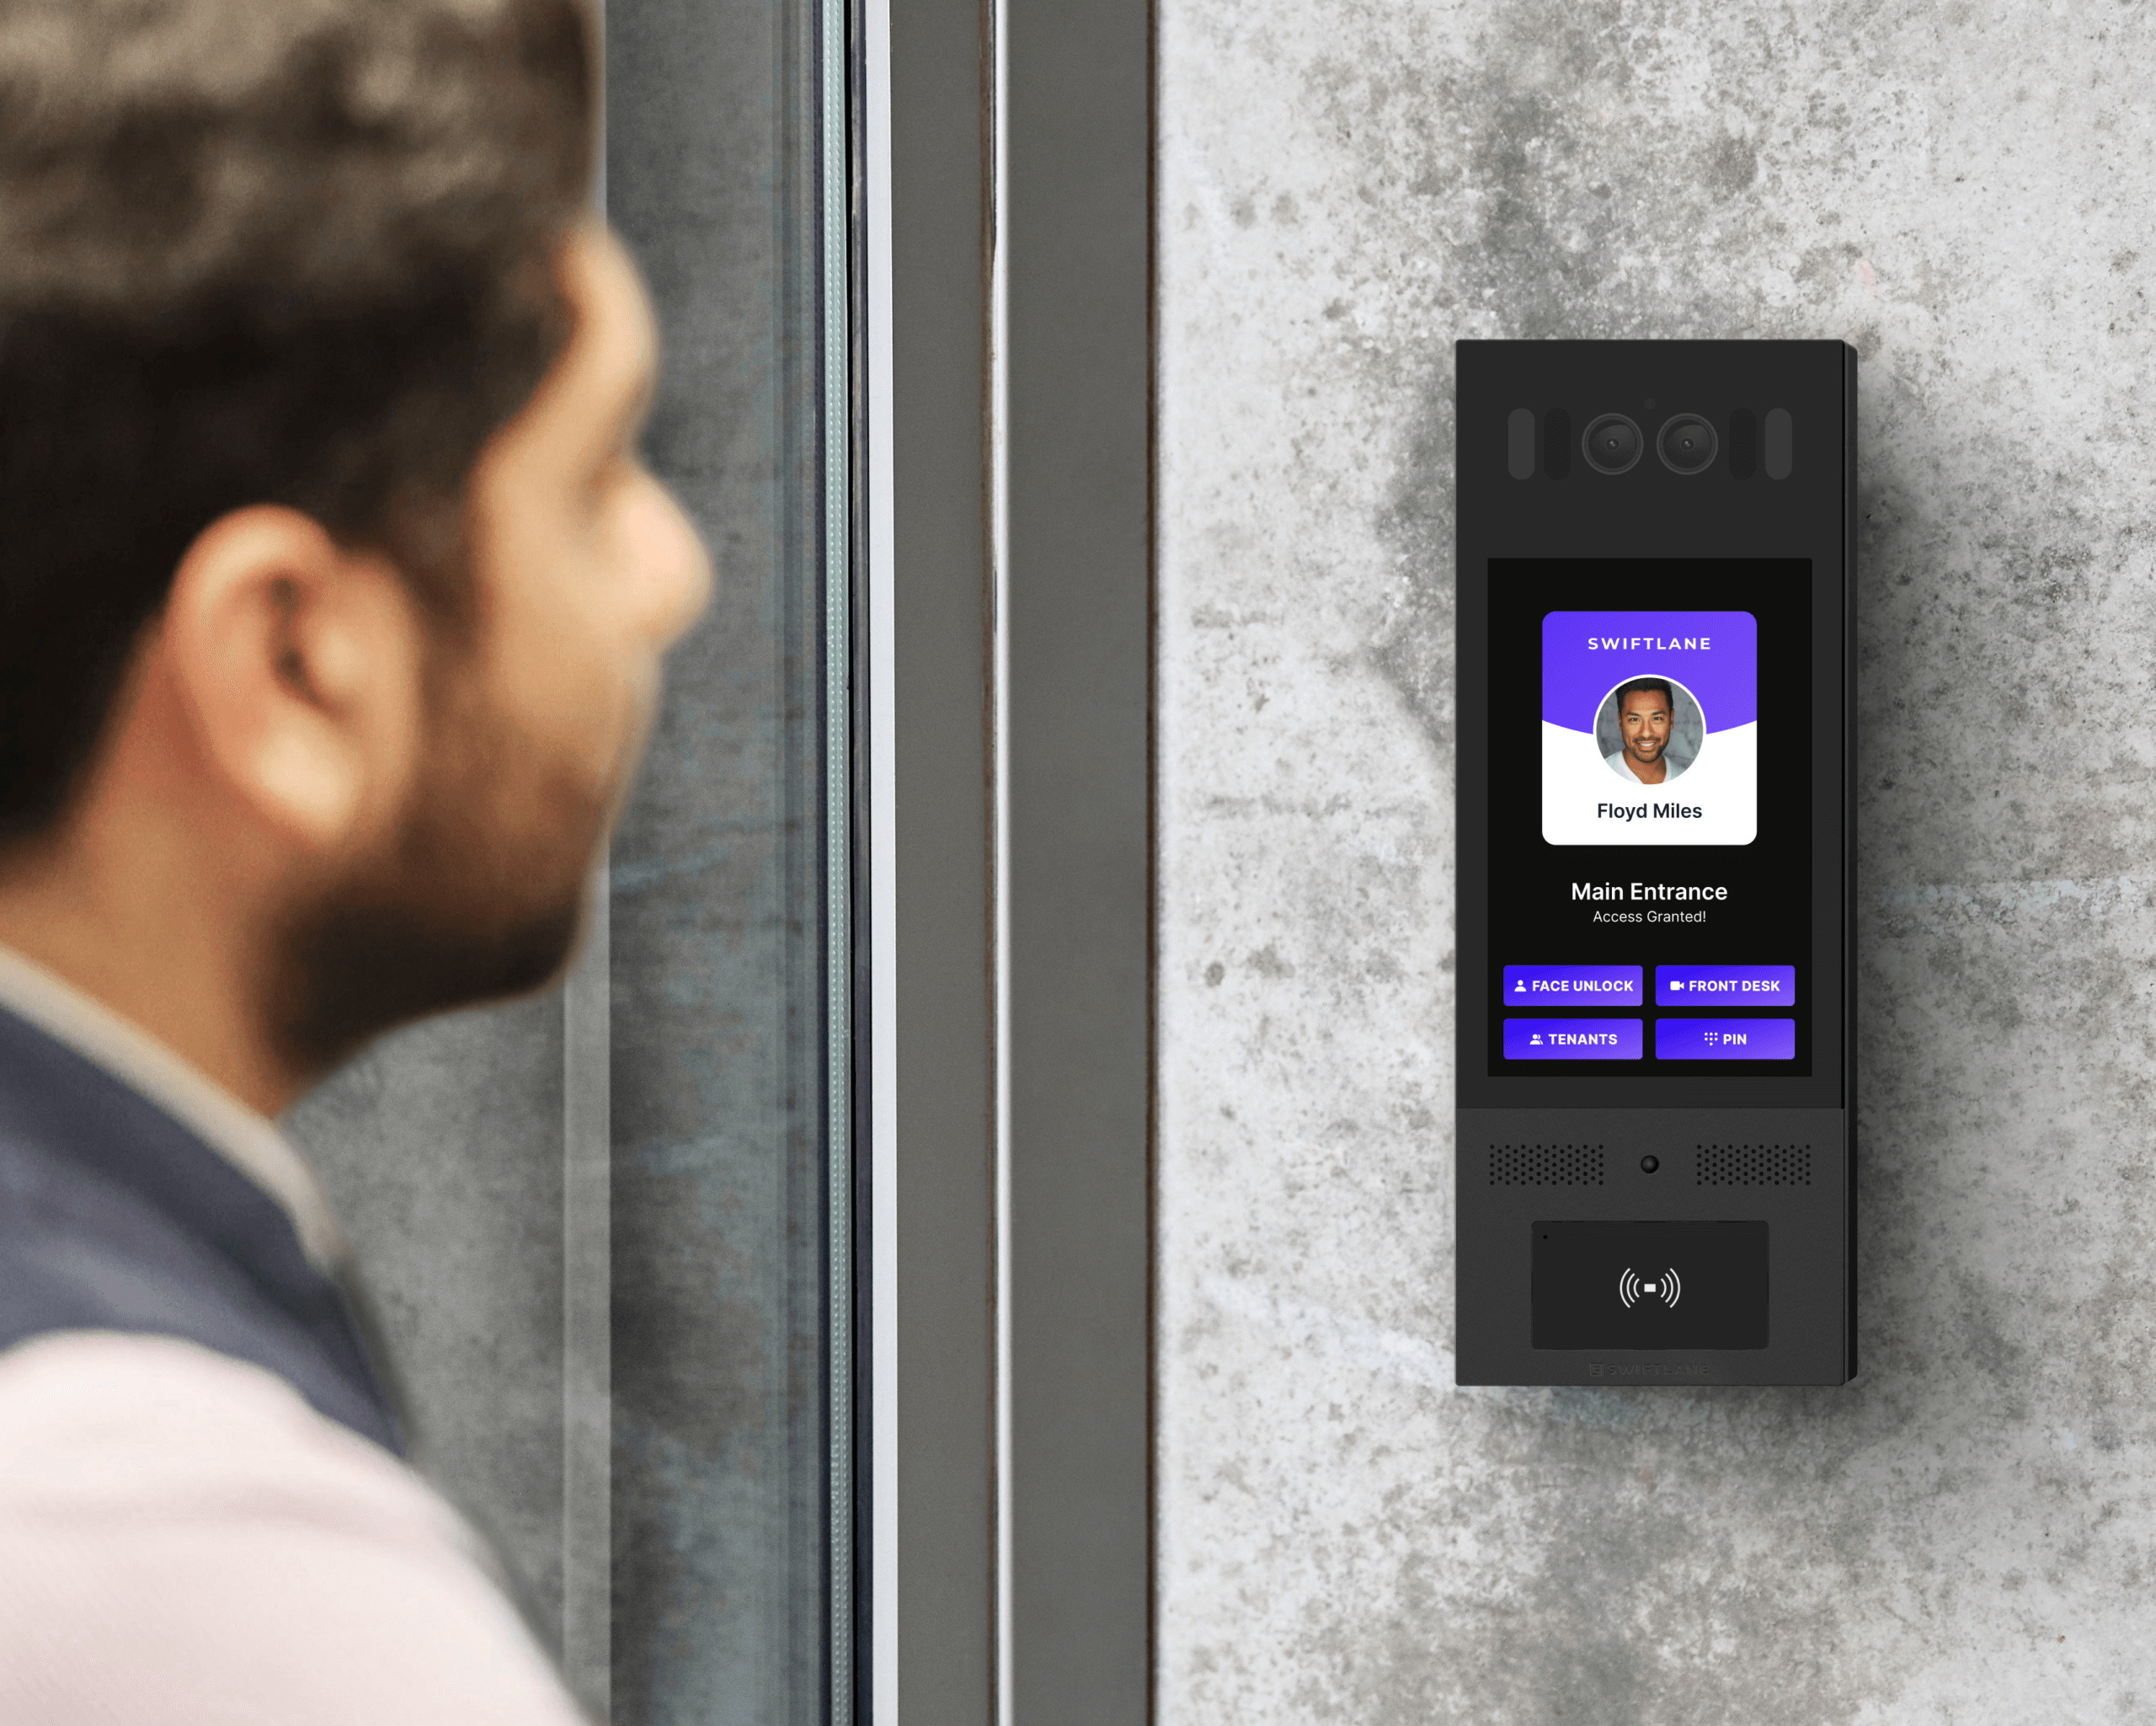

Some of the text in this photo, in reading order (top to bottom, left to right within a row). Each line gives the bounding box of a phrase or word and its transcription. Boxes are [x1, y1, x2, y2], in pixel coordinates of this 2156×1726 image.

[1588, 637, 1711, 650] SWIFTLANE
[1598, 803, 1703, 822] Floyd Miles
[1572, 882, 1728, 900] Main Entrance
[1593, 911, 1707, 923] Access Granted!
[1532, 980, 1634, 992] FACE UNLOCK
[1689, 980, 1780, 992] FRONT DESK
[1548, 1034, 1618, 1045] TENANTS
[1723, 1034, 1747, 1045] PIN
[1606, 1363, 1710, 1375] SWIFTLANE
